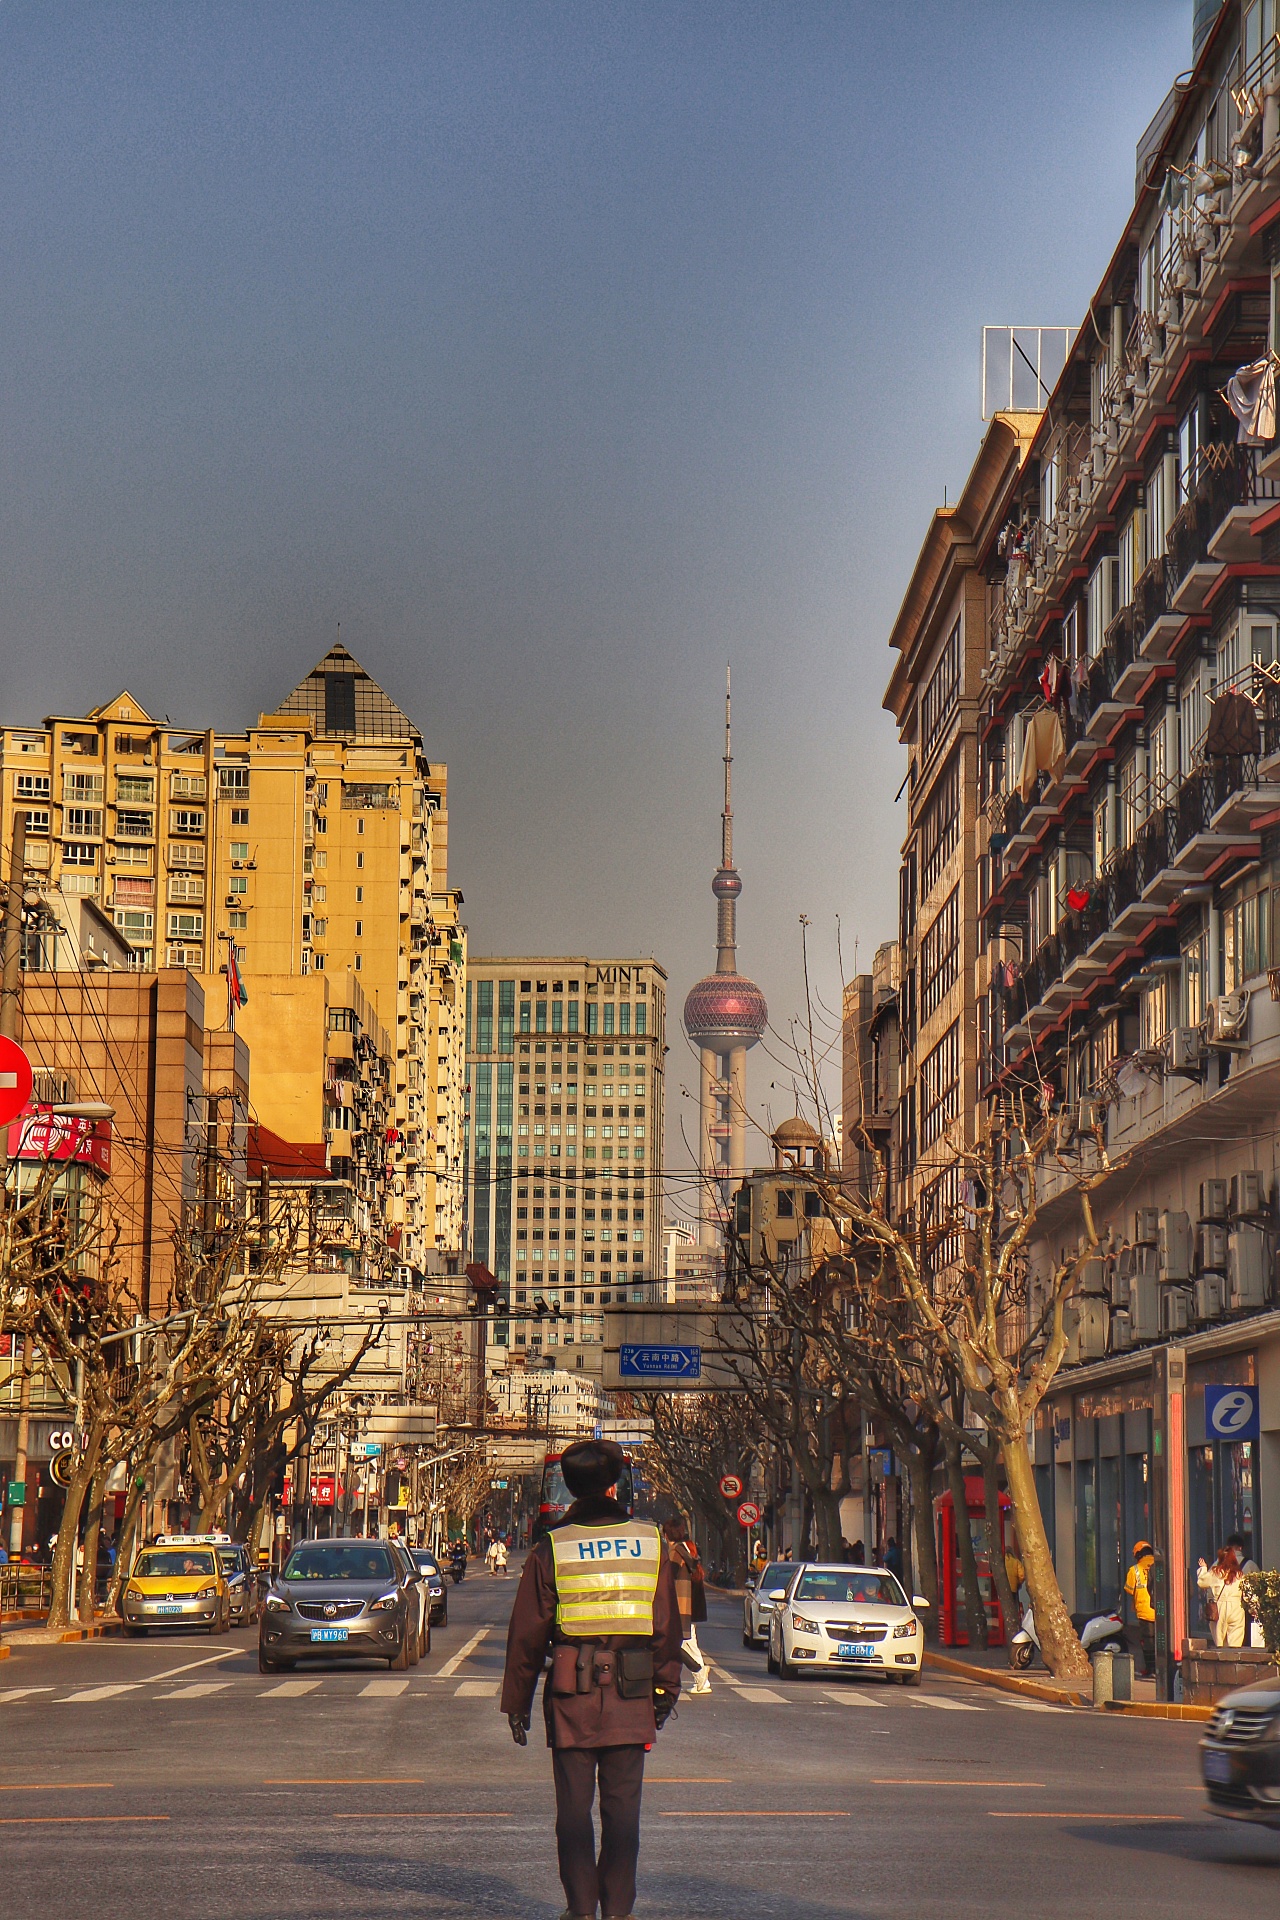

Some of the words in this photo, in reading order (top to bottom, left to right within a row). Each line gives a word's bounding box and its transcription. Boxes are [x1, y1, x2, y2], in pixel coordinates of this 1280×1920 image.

[642, 1353, 680, 1363] 云南中路
[578, 1539, 642, 1560] HPFJ
